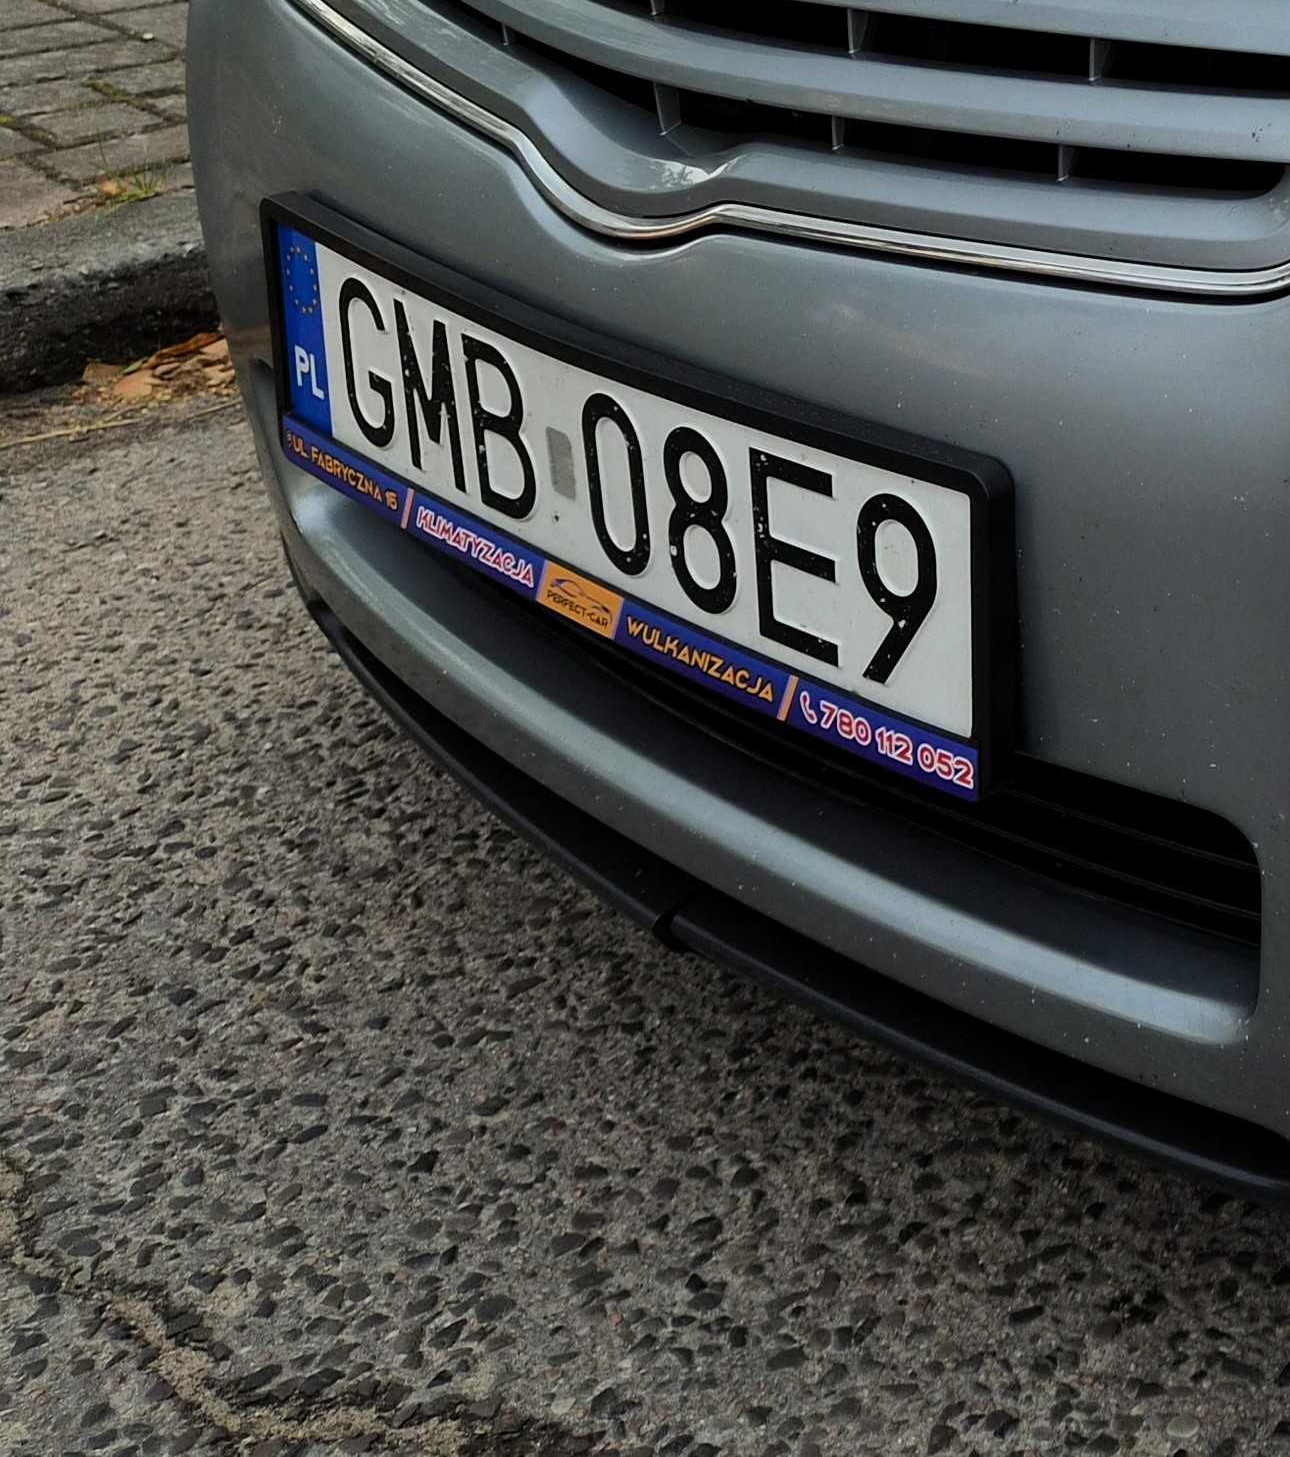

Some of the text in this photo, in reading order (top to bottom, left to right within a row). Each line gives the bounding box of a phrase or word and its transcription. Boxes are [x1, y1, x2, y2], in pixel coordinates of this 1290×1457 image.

[294, 345, 325, 400] PL
[311, 446, 382, 502] FABRYCZNA
[339, 276, 938, 684] GMB 08E9
[416, 506, 534, 587] KLIMATYZACJA
[627, 616, 773, 702] WULKANIZACJA
[820, 700, 974, 789] 780 112 052
